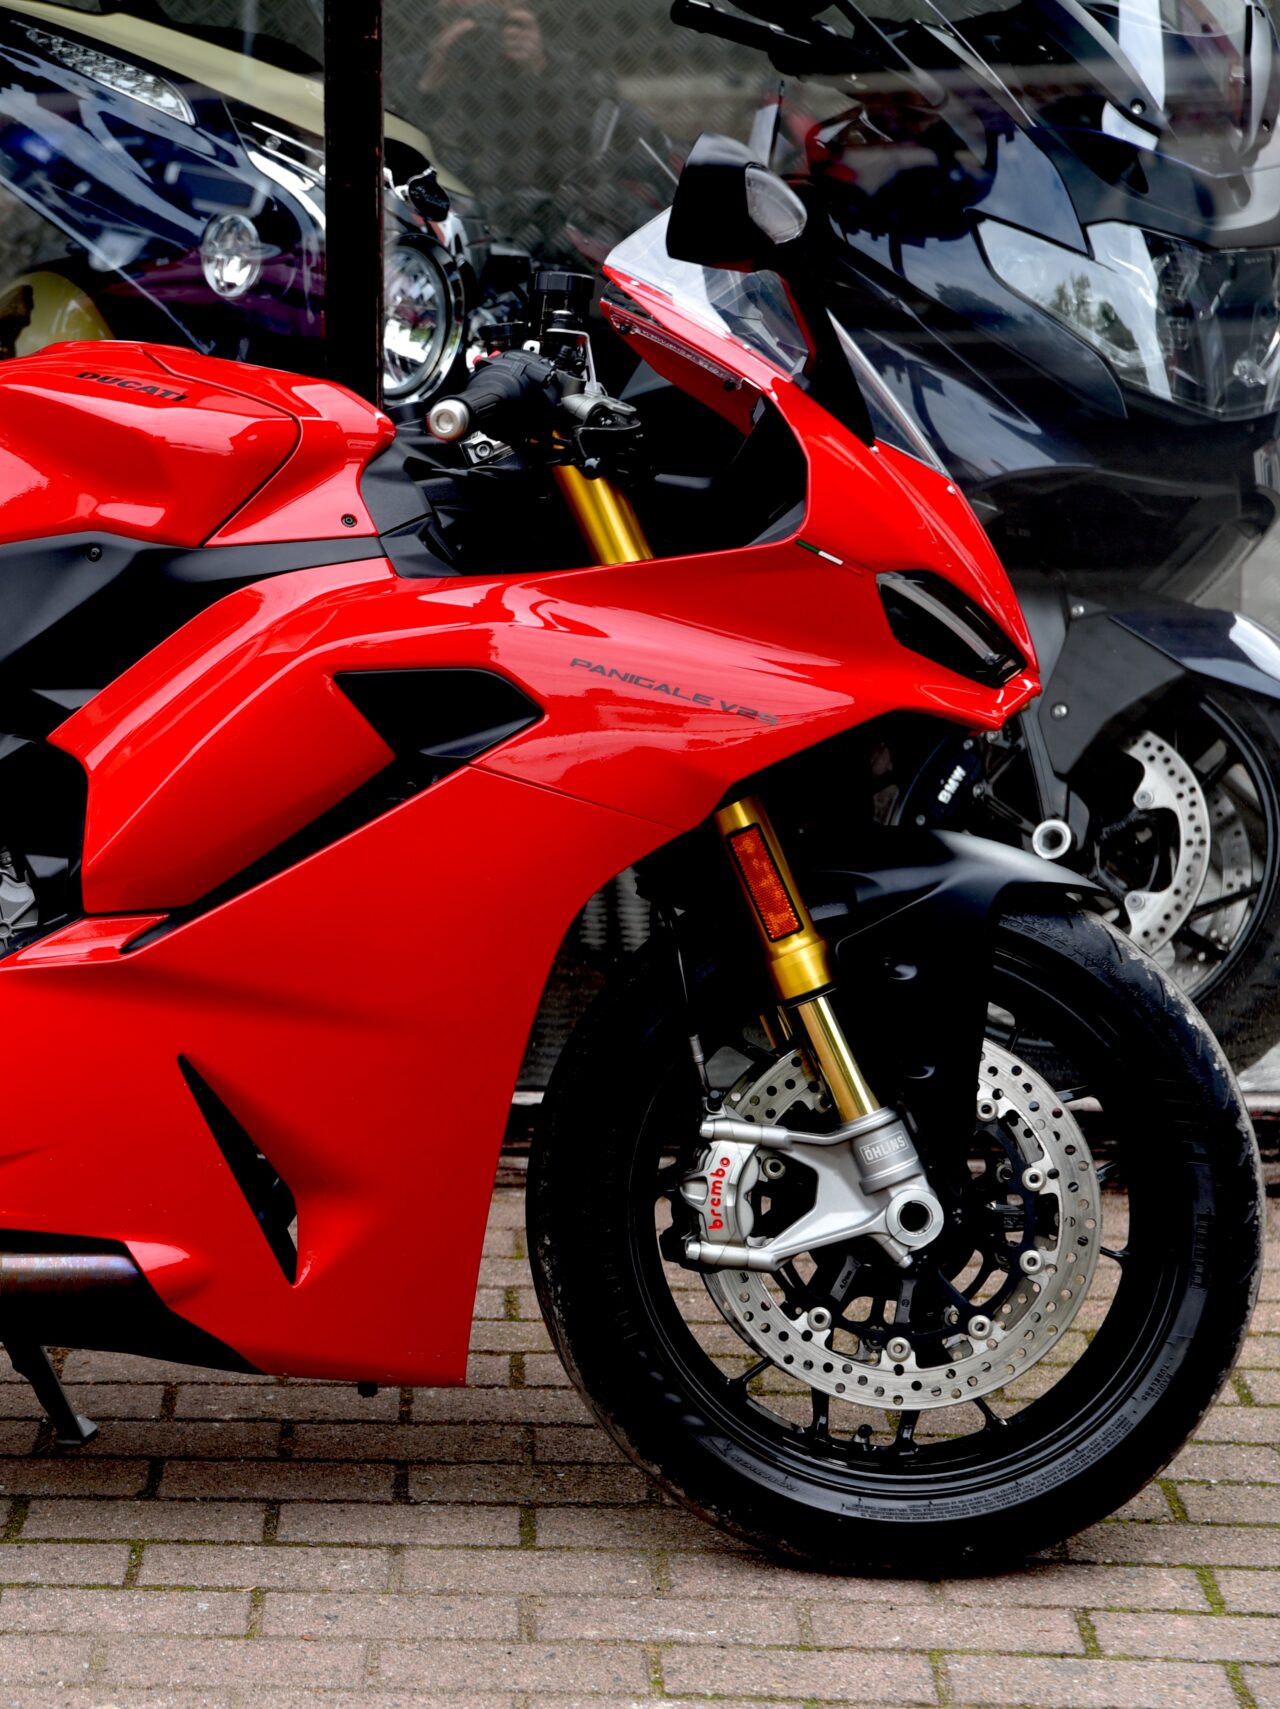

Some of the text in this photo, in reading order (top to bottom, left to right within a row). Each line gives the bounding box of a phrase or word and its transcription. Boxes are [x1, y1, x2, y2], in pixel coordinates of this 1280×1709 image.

[75, 371, 189, 402] DUCATI
[569, 657, 715, 707] PANIGALE
[937, 764, 966, 804] BMW
[863, 1134, 907, 1165] ÖHLINS
[708, 1156, 731, 1231] brembo
